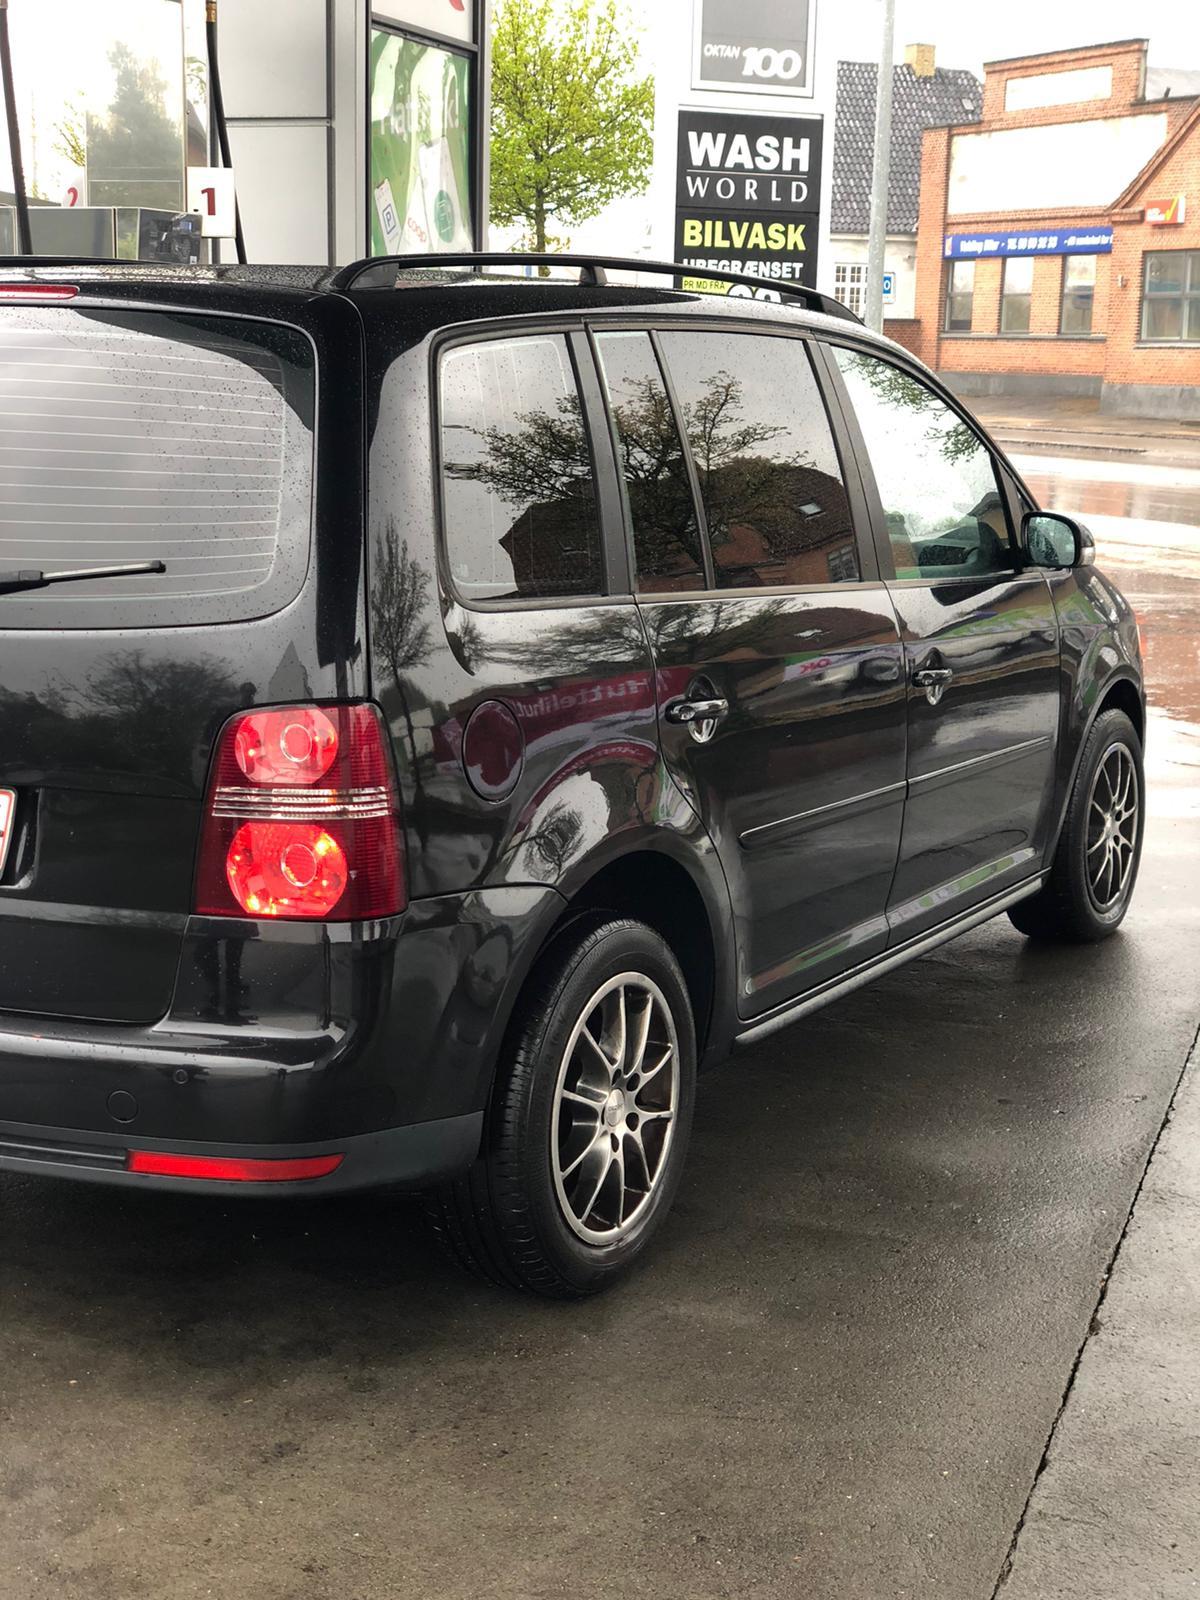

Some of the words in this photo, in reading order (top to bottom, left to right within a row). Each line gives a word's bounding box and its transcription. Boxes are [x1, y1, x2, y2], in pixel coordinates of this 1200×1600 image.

[704, 43, 741, 59] OKTAN
[741, 47, 802, 80] 100
[687, 131, 810, 172] WASH
[201, 187, 216, 216] 1
[686, 176, 808, 203] WORLD
[683, 219, 806, 251] BILVASK
